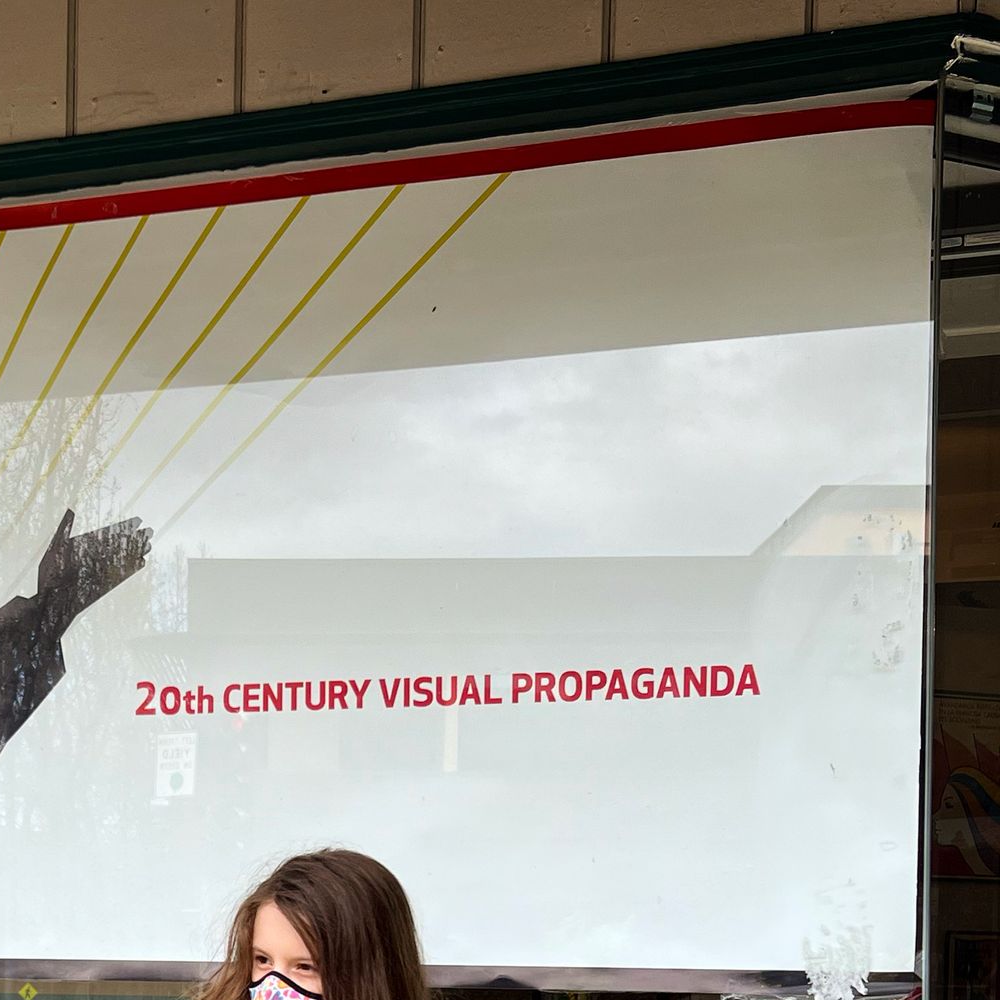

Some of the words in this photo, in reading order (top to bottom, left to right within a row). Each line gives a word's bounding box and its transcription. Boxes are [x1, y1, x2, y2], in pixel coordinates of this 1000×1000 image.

[135, 680, 214, 716] 20th
[223, 679, 372, 713] CENTURY
[379, 673, 502, 709] VISUAL
[511, 663, 761, 705] PROPAGANDA
